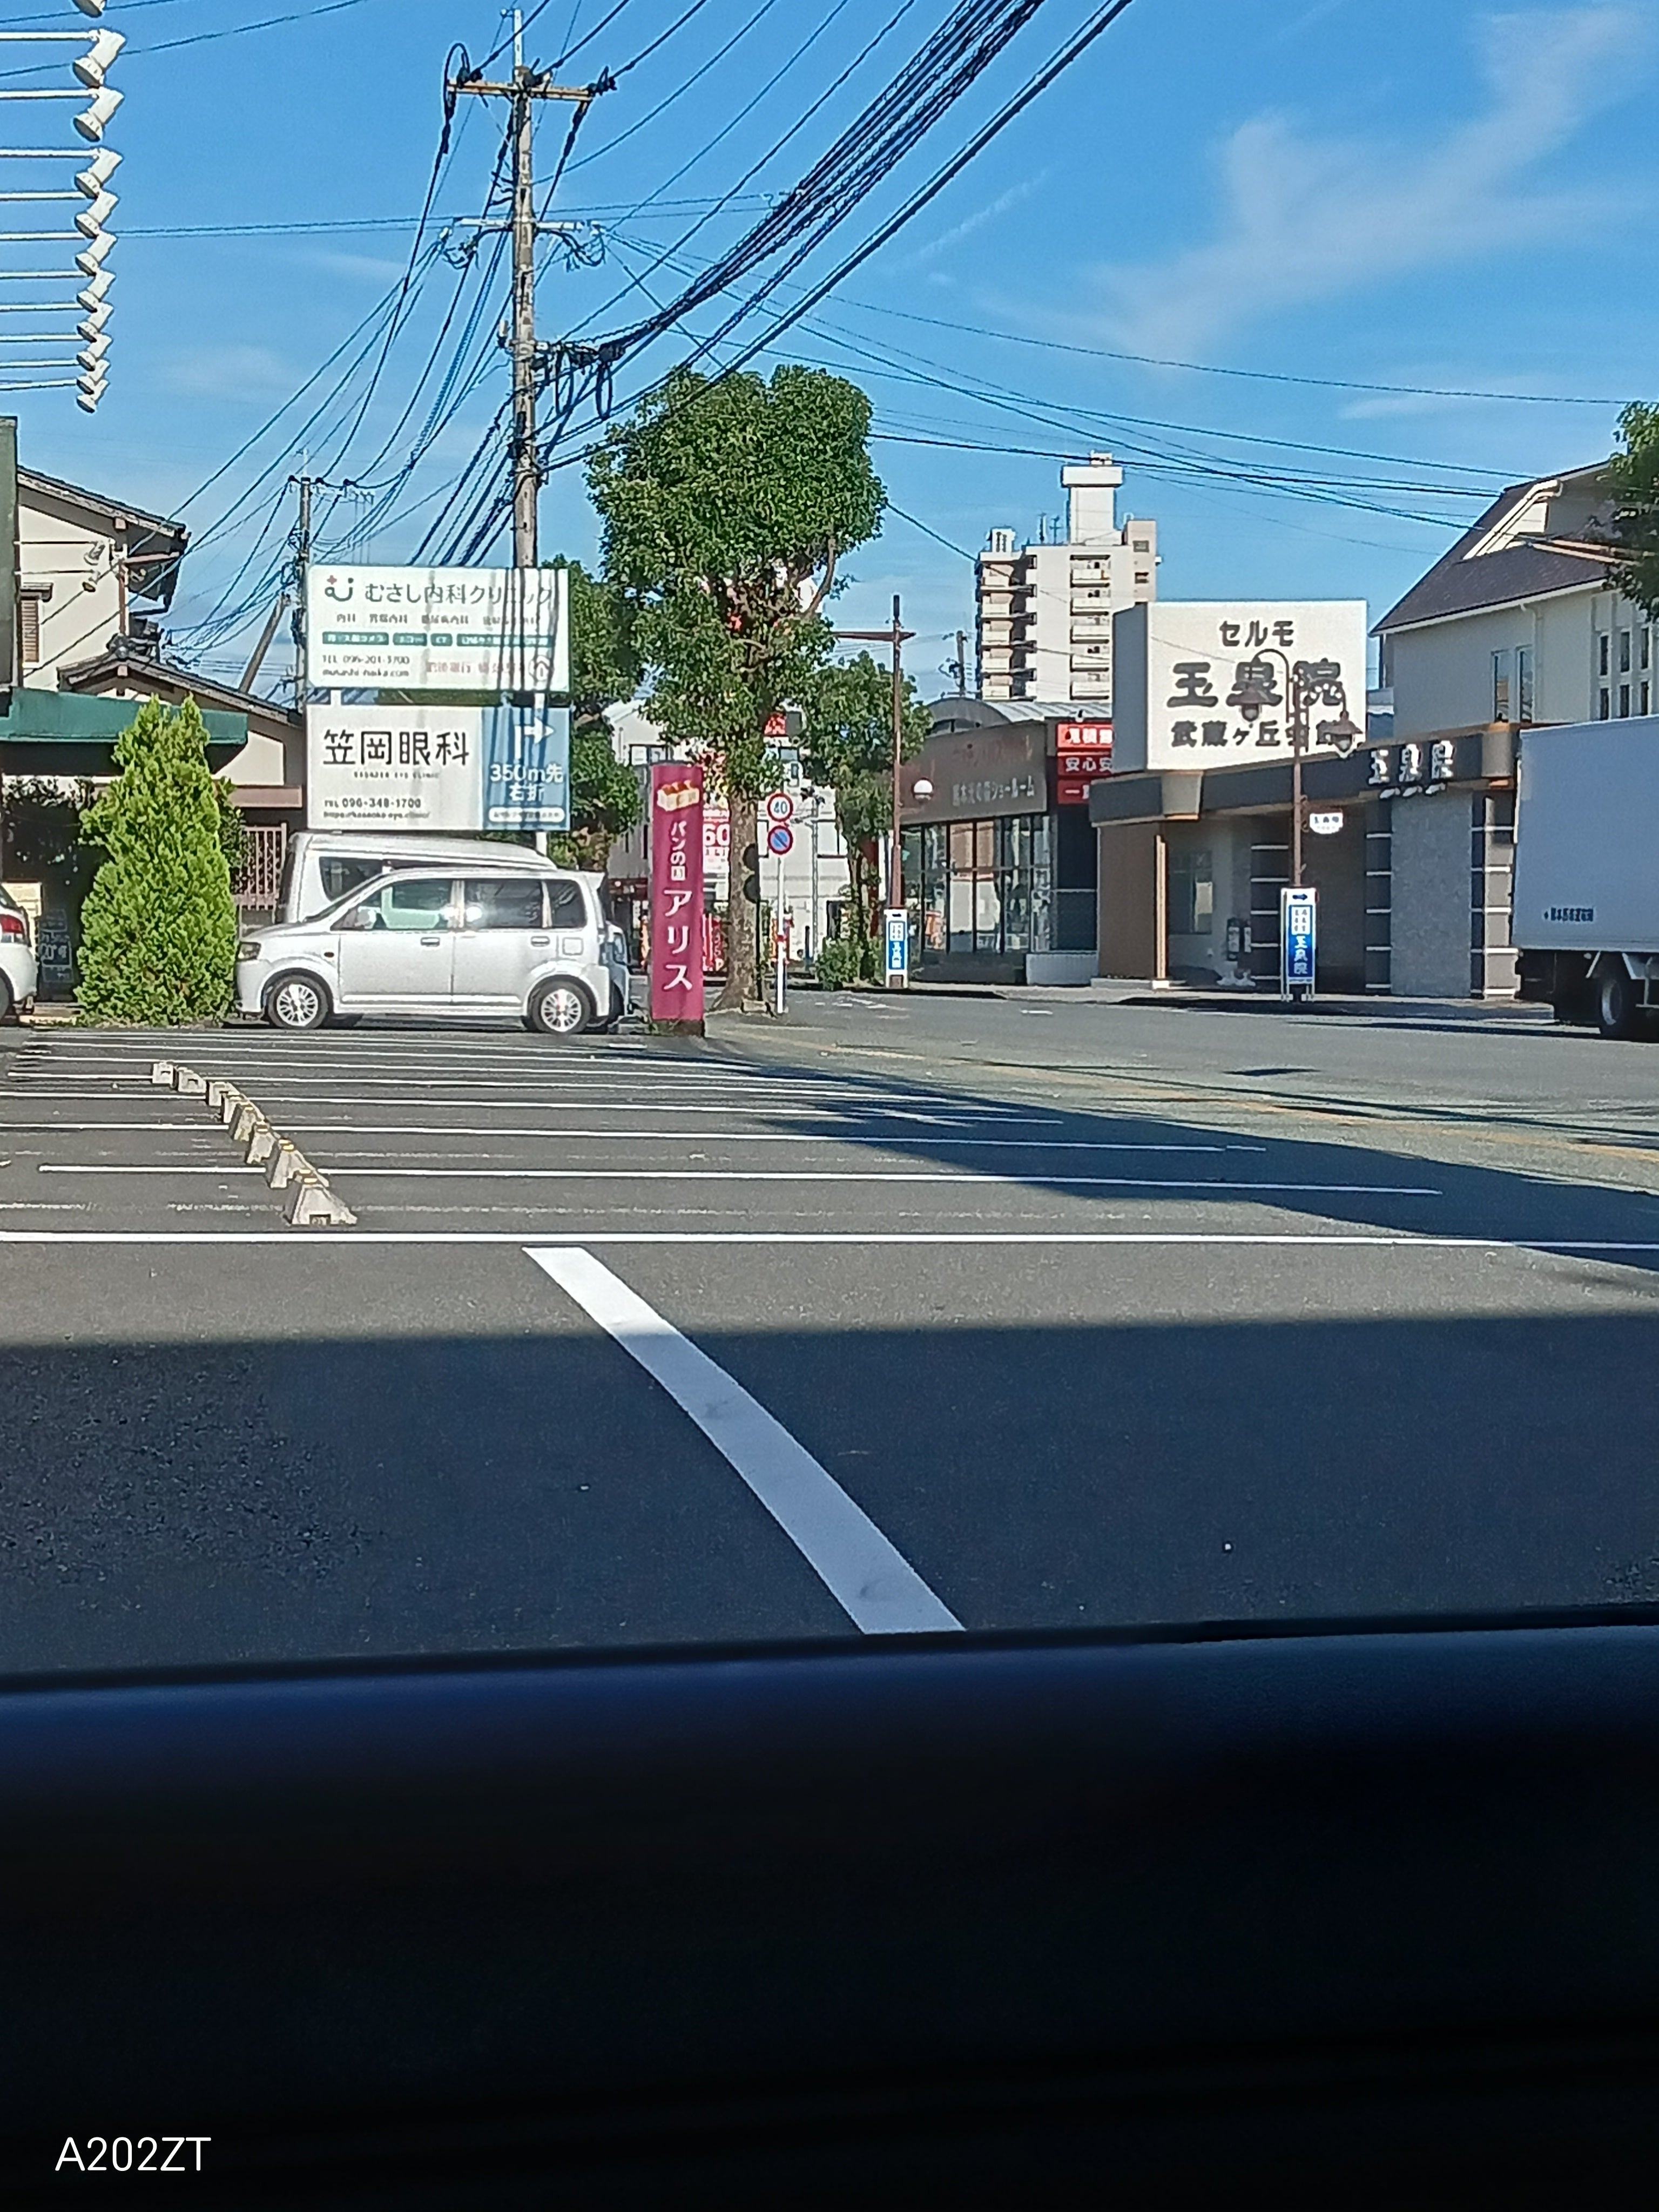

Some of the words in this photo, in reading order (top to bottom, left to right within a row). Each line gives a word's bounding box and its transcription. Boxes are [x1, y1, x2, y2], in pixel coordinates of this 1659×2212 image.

[1219, 620, 1294, 647] セルモ
[323, 729, 469, 766] 笠岡眼科
[490, 763, 564, 783] 350m先
[774, 801, 788, 814] 40
[663, 889, 693, 990] アリス
